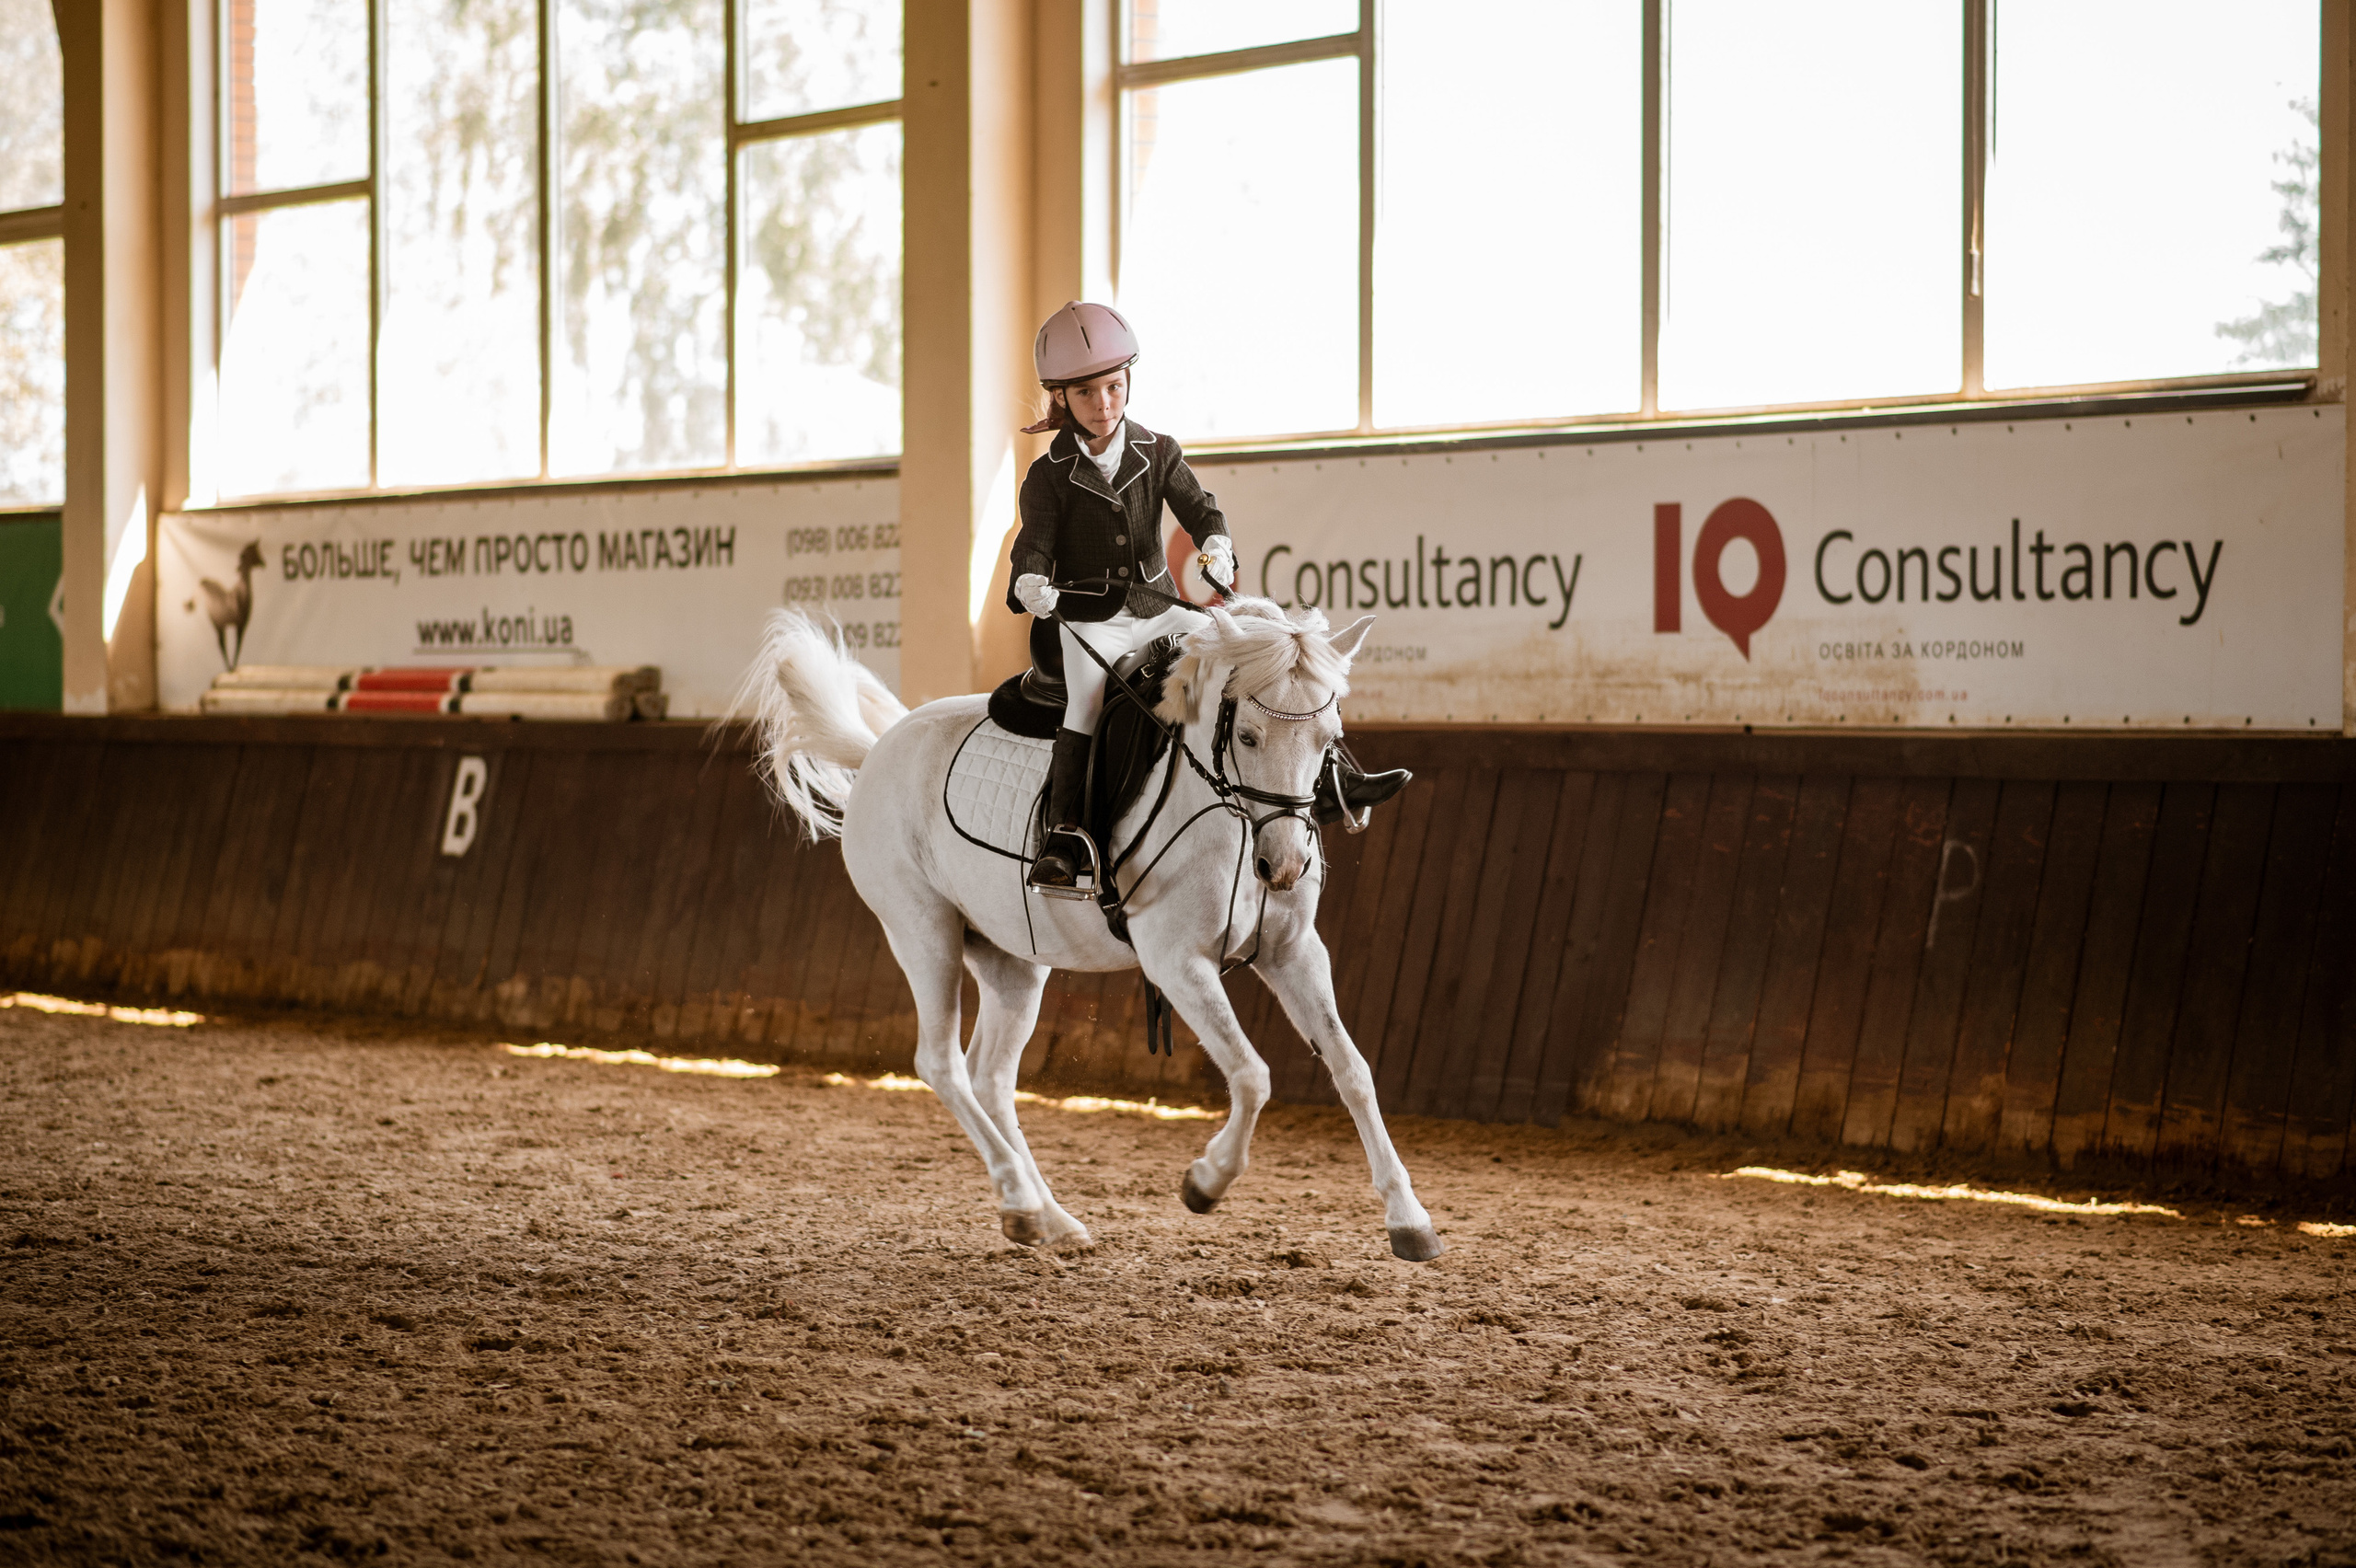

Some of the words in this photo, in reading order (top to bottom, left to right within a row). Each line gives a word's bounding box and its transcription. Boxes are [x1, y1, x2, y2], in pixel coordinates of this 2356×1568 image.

[283, 540, 401, 588] БОЛЬШЕ,
[410, 536, 466, 577] ЧЕМ
[474, 531, 590, 574] ПРОСТО
[598, 525, 736, 571] МАГАЗИН
[1261, 535, 1582, 630] Consultancy
[1814, 518, 2224, 627] Consultancy
[417, 605, 573, 646] www.koni.ua
[1819, 641, 1885, 660] ОСВІТА
[1891, 641, 1914, 659] ЗА
[1921, 640, 2025, 660] КОРДОНОМ
[441, 755, 488, 858] B
[1926, 838, 1979, 949] P
